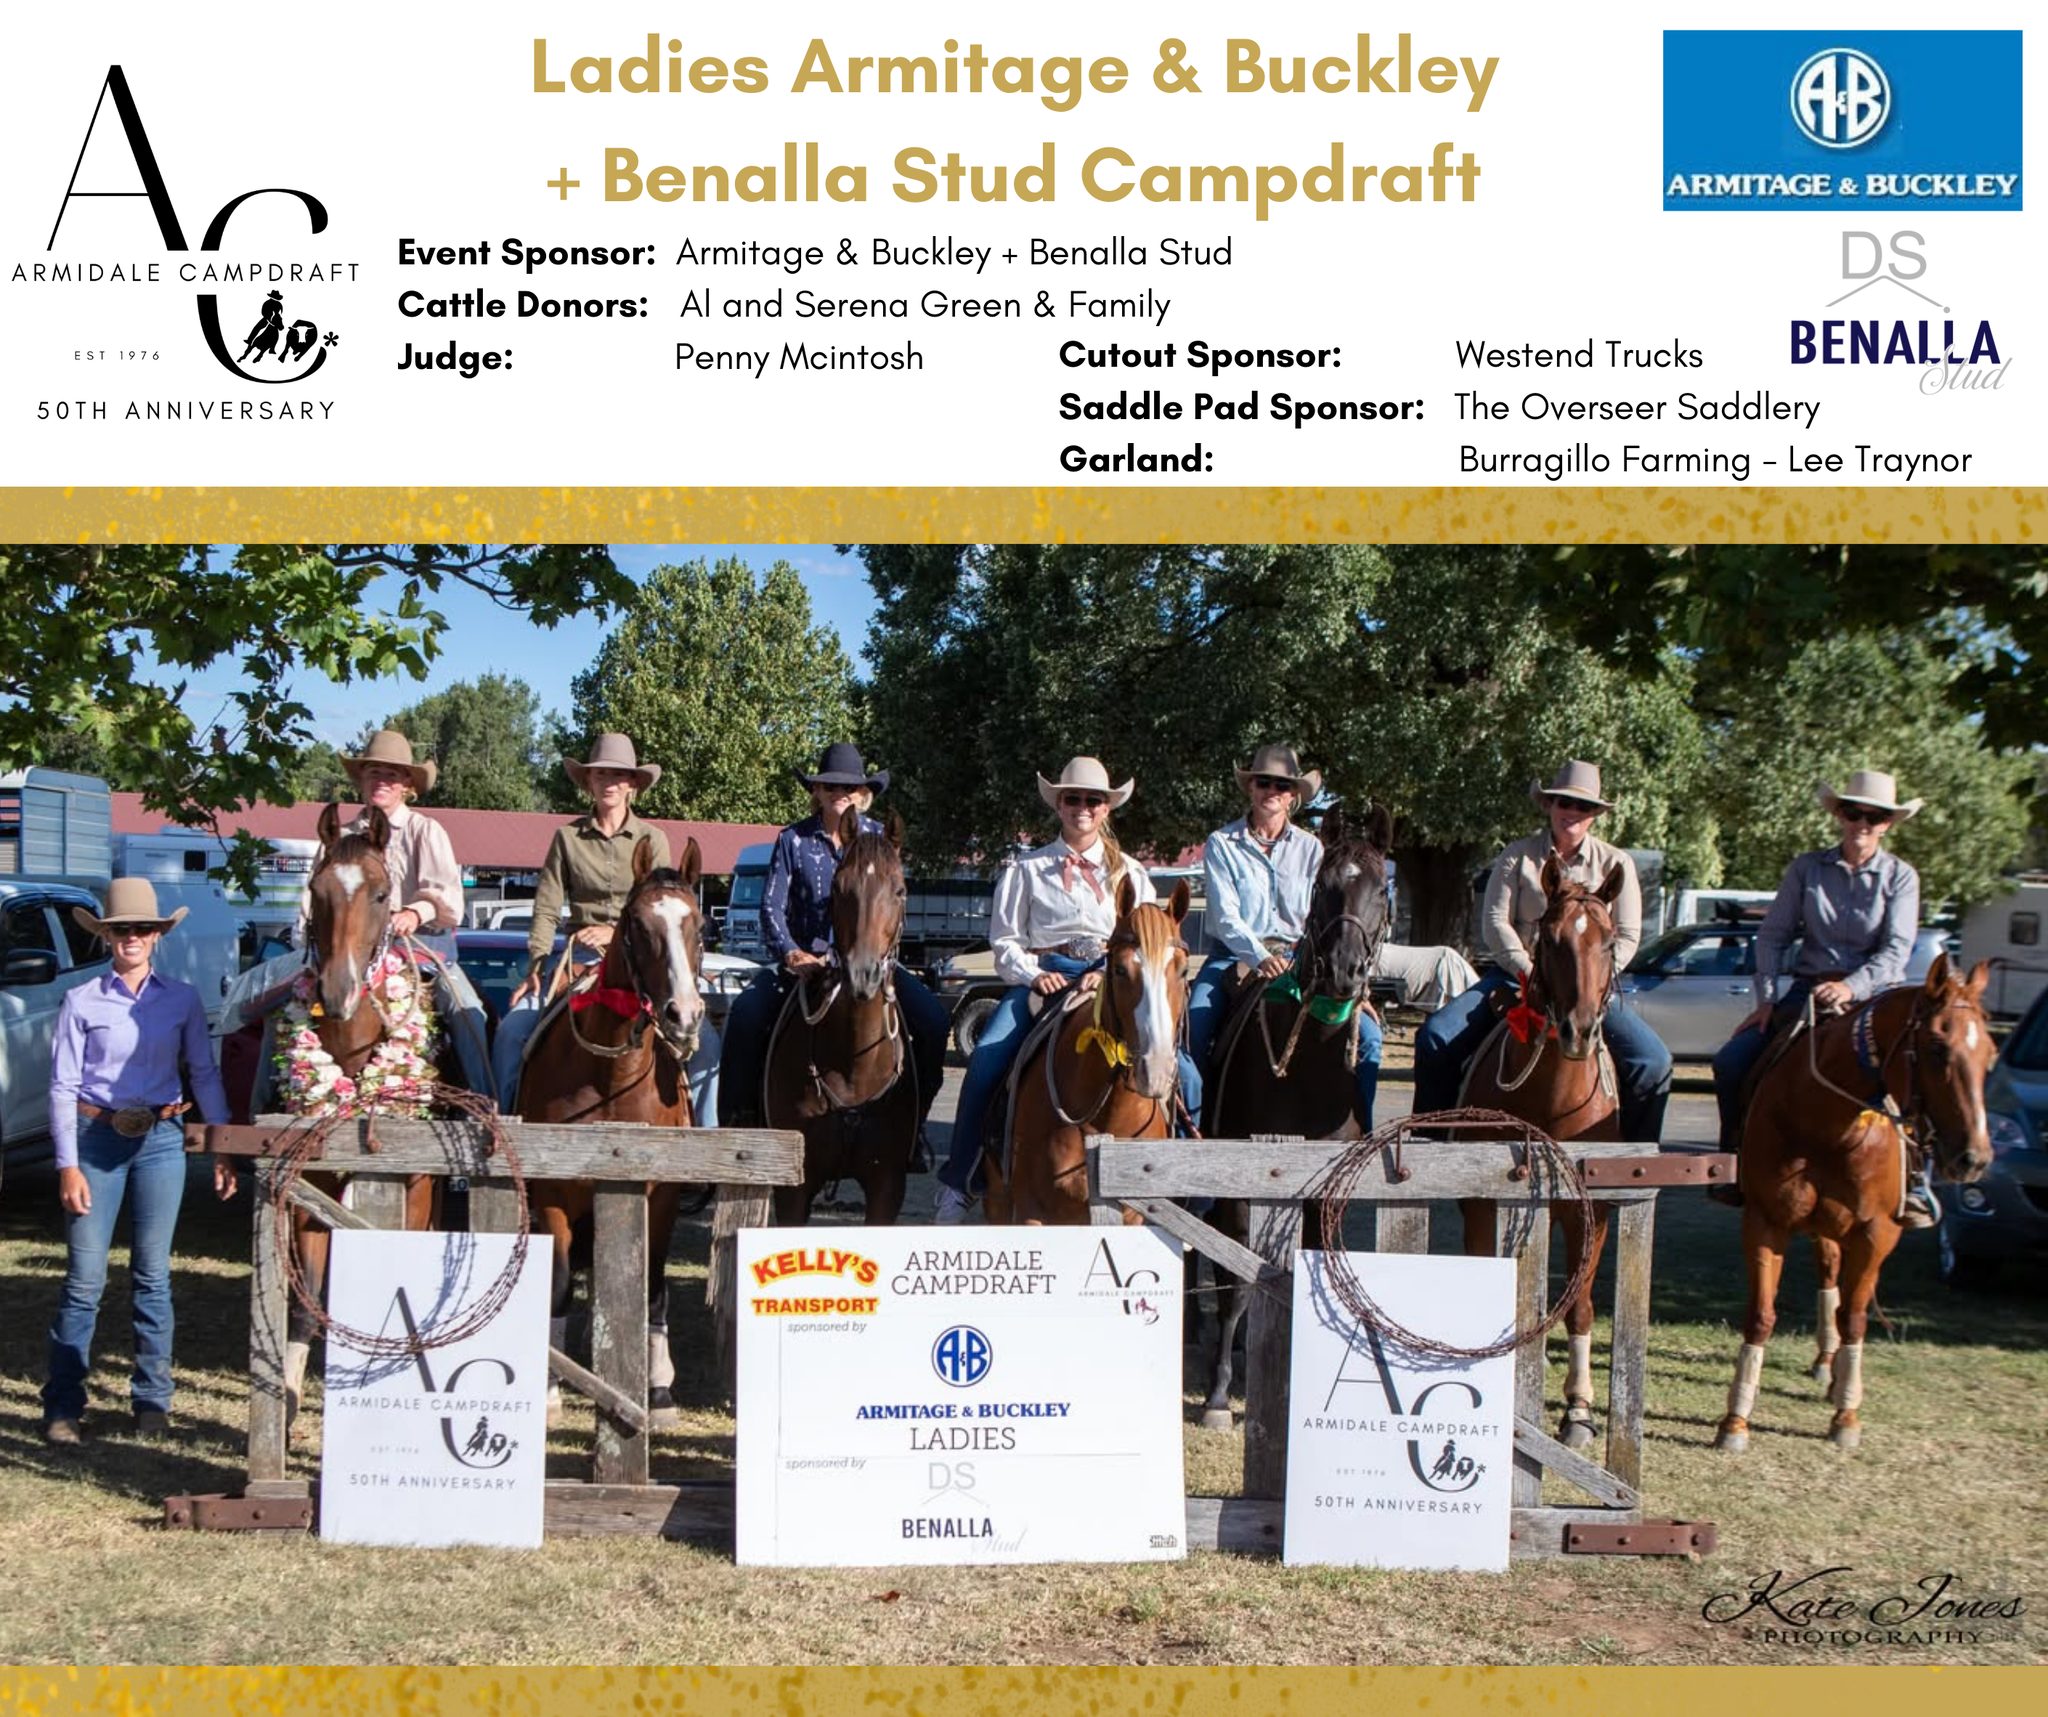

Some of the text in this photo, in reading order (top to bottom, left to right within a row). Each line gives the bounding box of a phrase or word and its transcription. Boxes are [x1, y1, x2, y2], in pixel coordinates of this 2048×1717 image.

[904, 1250, 1043, 1272] ARMIDALE
[891, 1274, 1057, 1295] CAMPDRAFT
[752, 1297, 878, 1315] TRANSPORT
[787, 1321, 867, 1334] sponsored by
[338, 1396, 532, 1413] ARMIDALE CAMPDRAFT
[856, 1402, 1071, 1419] ARMITAGE & BUCKLEY
[1303, 1417, 1500, 1437] ARMIDALE CAMPDRAFT
[910, 1426, 1016, 1450] LADIES
[785, 1456, 867, 1470] sponsored by
[349, 1474, 516, 1491] 50TH ANNIVERSARY
[929, 1461, 976, 1490] DS
[1314, 1495, 1484, 1515] 50TH ANNIVERSARY
[902, 1517, 993, 1538] BENALLA
